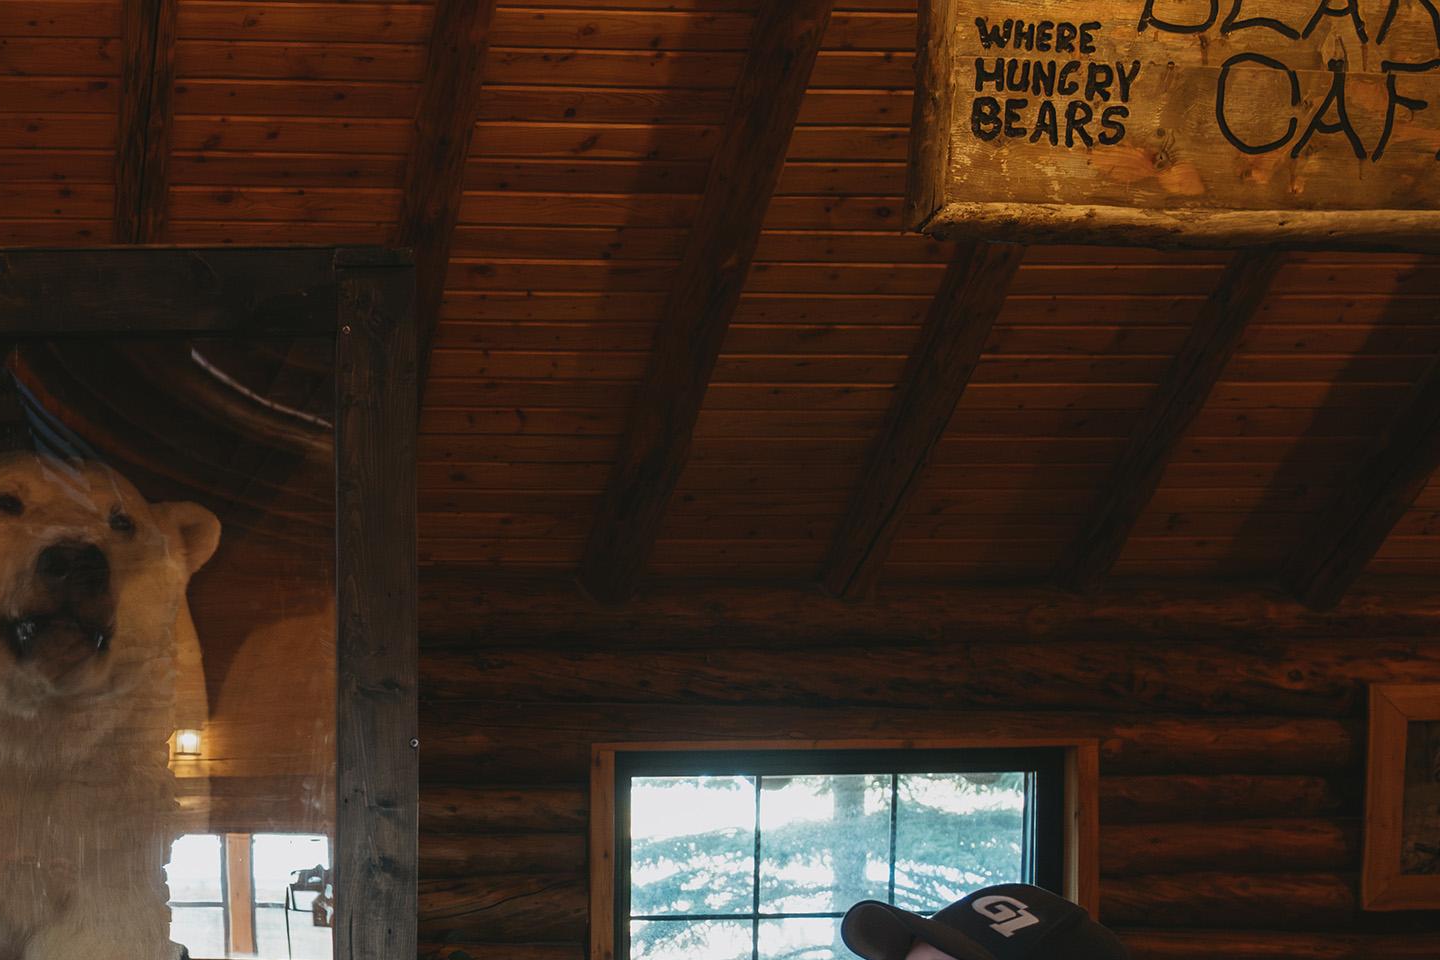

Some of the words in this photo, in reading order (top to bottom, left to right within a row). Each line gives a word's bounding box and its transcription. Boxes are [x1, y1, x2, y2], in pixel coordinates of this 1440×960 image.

[975, 16, 1103, 54] WHERE
[973, 57, 1141, 102] HUNGRY
[970, 96, 1130, 148] BEARS
[1216, 51, 1440, 162] CAF
